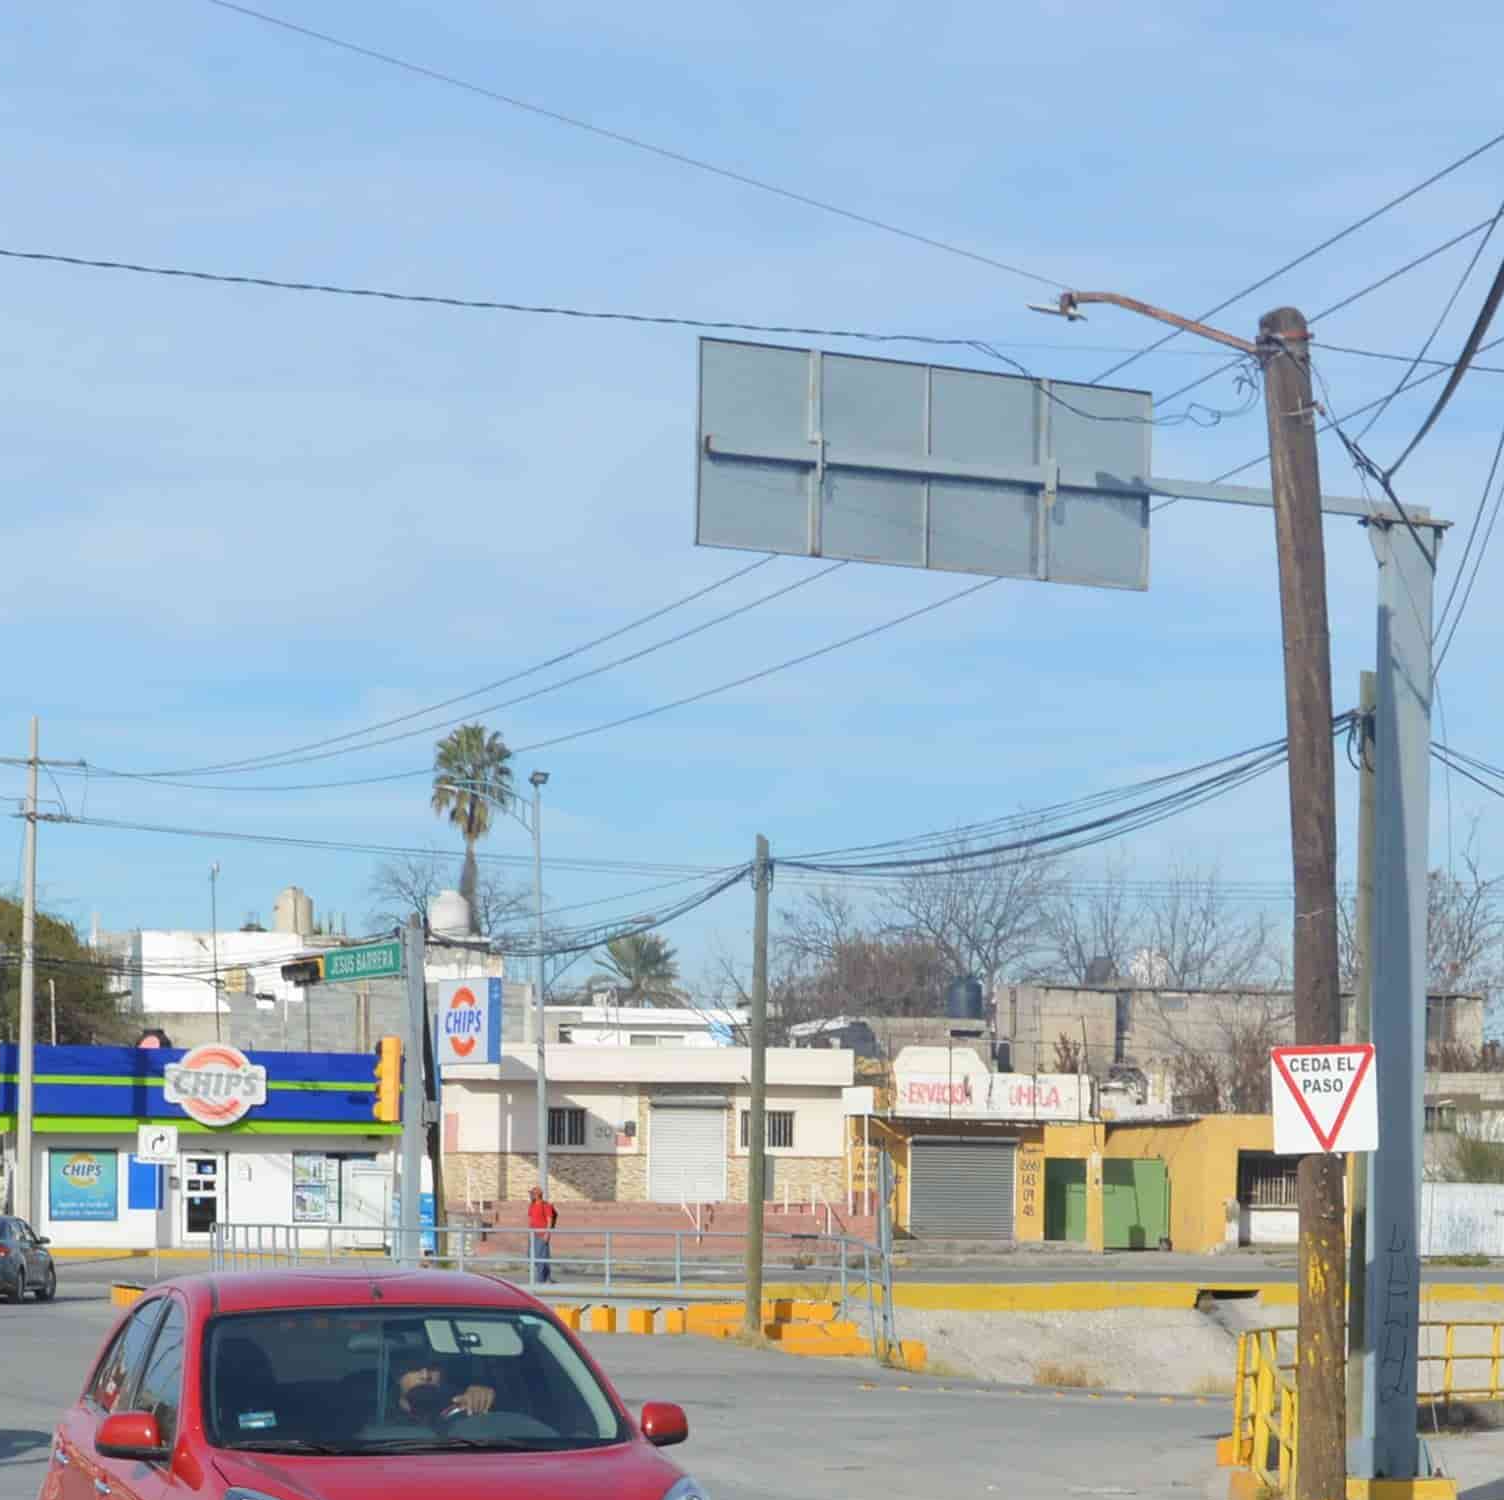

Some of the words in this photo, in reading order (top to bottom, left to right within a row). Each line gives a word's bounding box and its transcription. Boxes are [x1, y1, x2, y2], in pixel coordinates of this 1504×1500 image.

[330, 954, 354, 976] JESUS
[355, 948, 394, 971] BARRERA
[1289, 1057, 1332, 1072] CEDA
[1336, 1056, 1355, 1071] EL
[1302, 1078, 1344, 1093] PASO
